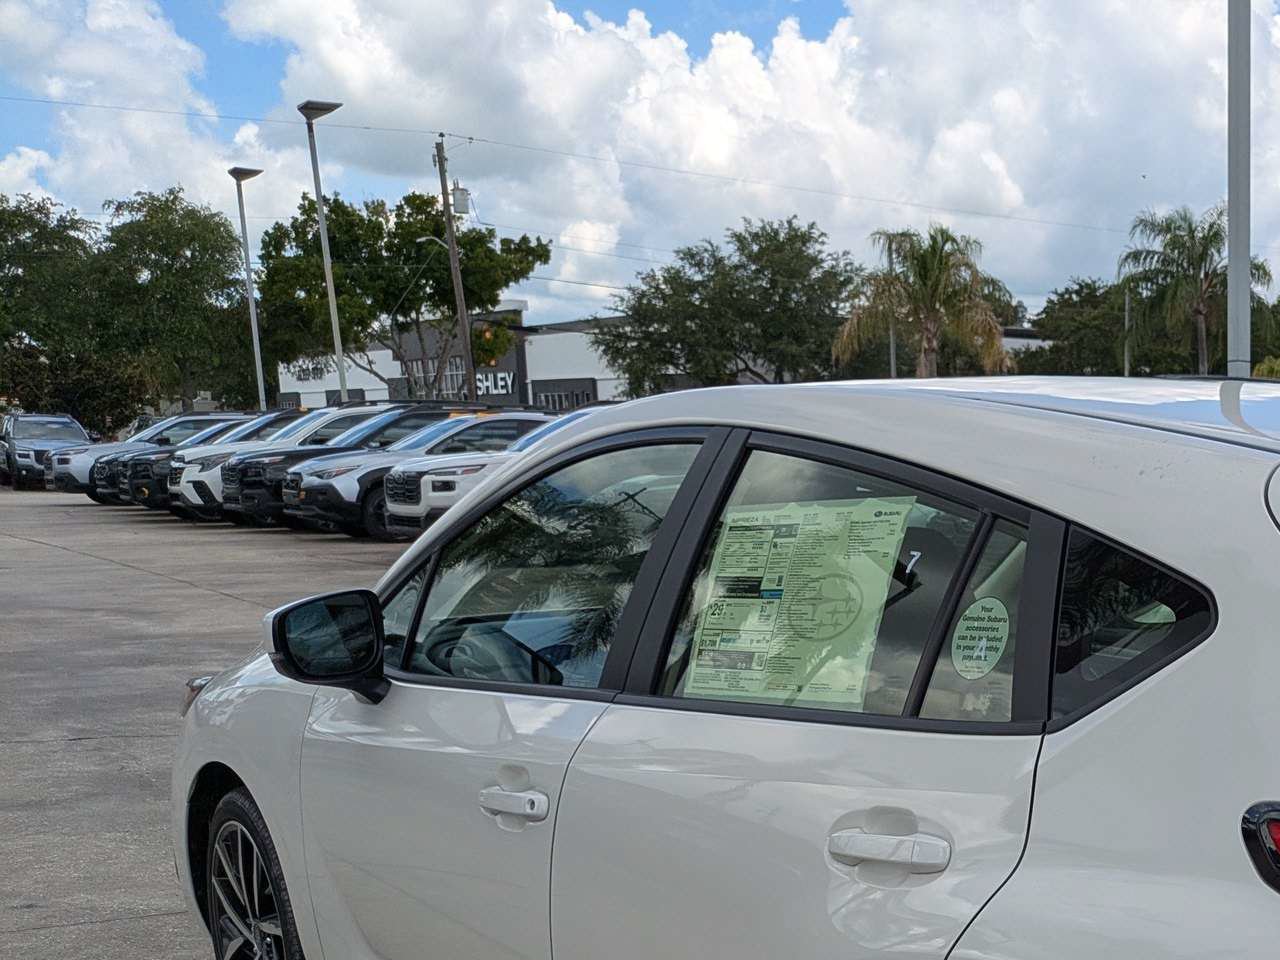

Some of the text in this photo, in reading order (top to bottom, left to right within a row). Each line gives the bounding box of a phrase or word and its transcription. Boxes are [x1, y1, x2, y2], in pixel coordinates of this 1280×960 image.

[475, 371, 514, 396] SHLEY
[906, 550, 922, 574] 7
[987, 615, 1008, 623] Subaru
